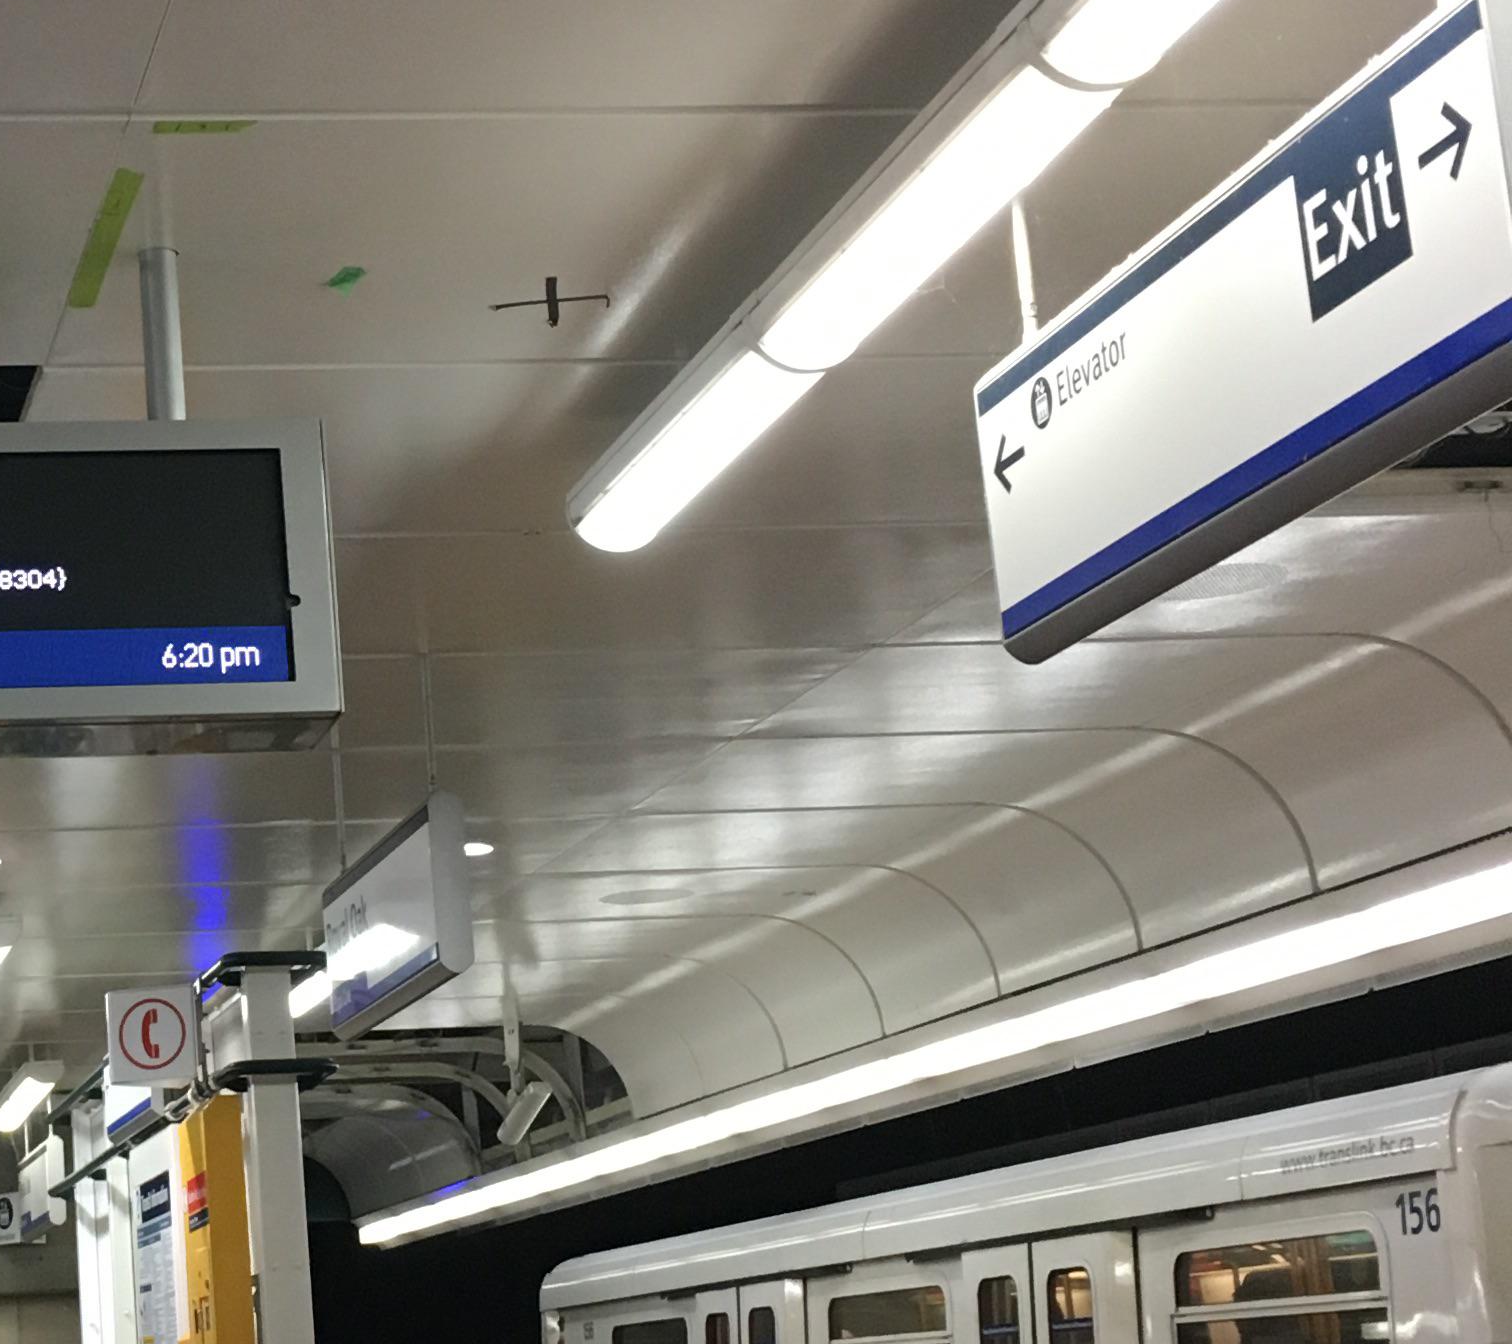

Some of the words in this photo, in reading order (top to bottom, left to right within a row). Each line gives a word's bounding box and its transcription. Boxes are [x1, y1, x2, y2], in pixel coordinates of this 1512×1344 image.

[1303, 149, 1401, 282] Exit
[1056, 331, 1126, 407] Elevator
[162, 642, 214, 668] 6:20
[220, 646, 260, 674] pm
[1395, 1187, 1441, 1236] 156
